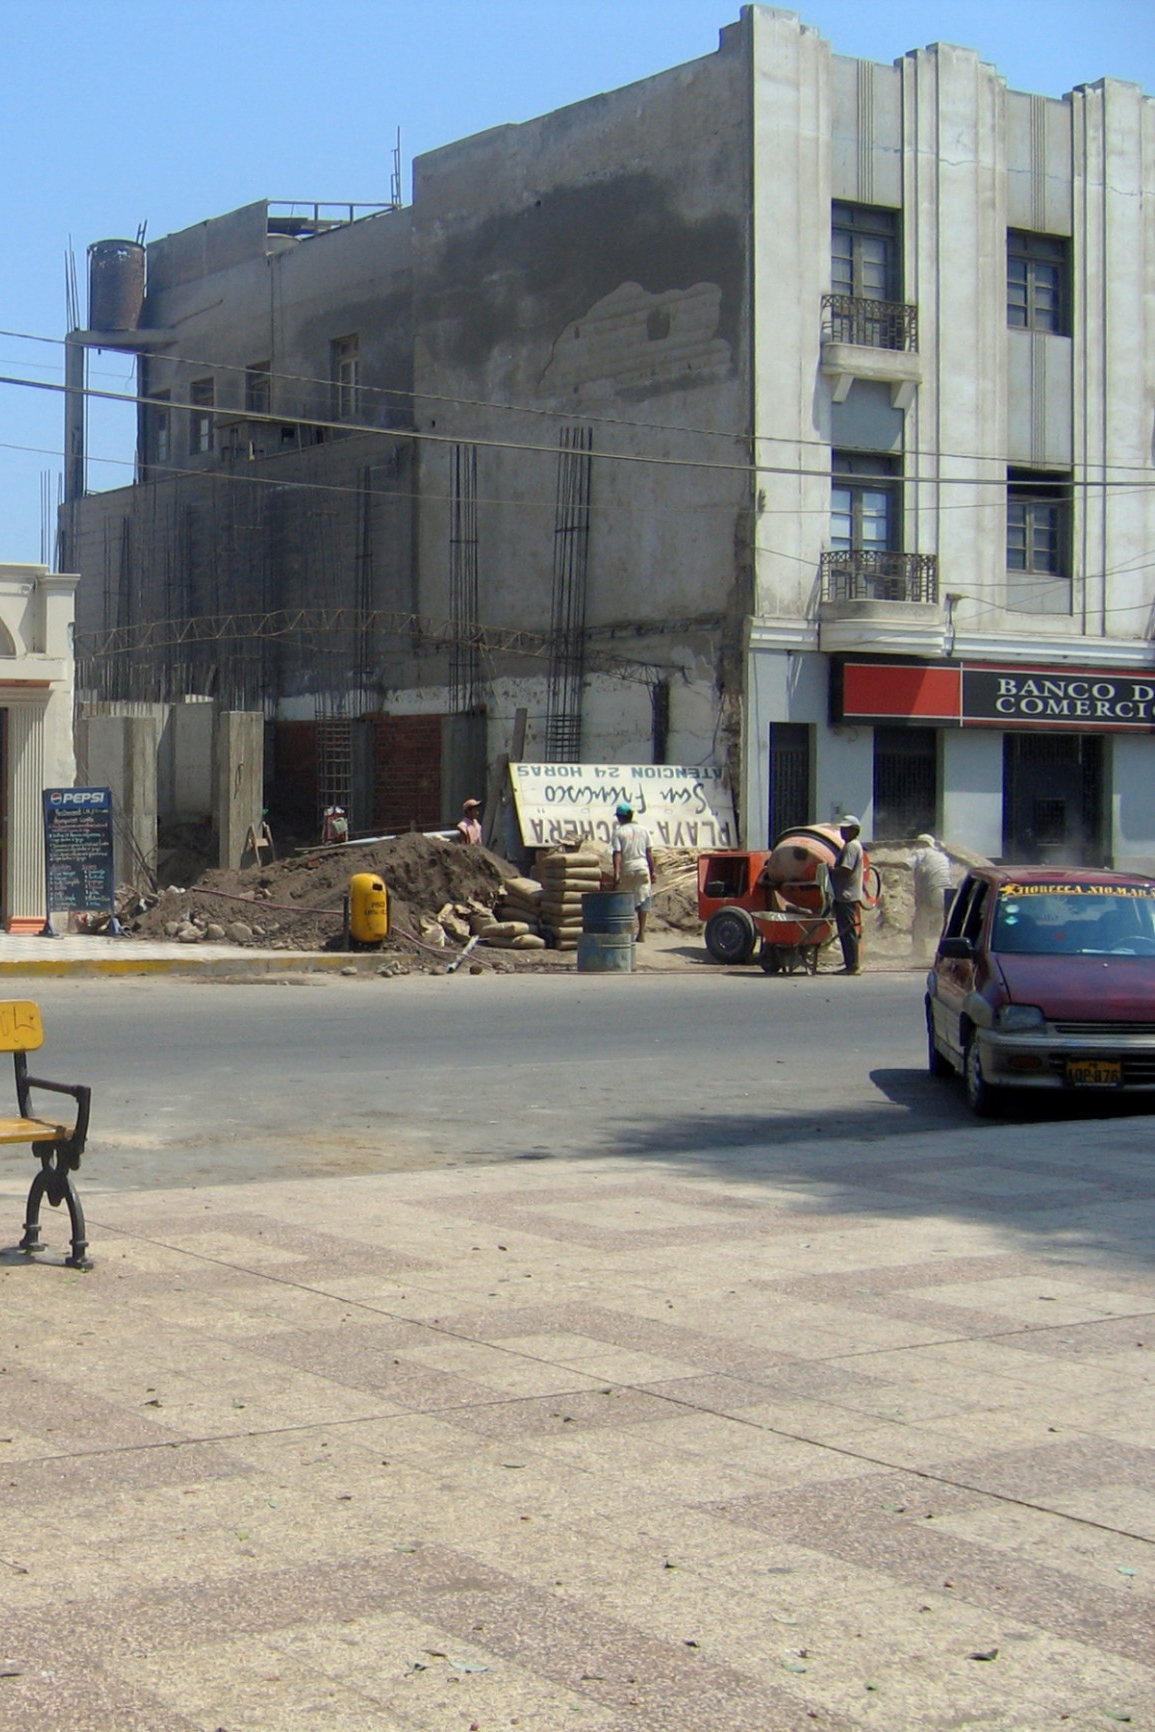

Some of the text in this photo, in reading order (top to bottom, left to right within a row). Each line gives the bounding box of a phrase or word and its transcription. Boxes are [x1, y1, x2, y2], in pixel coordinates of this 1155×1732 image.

[997, 678, 1155, 701] BANCO D
[516, 765, 723, 779] ATENCION 24 HORAS
[62, 792, 105, 804] PEPSI
[529, 818, 637, 843] CHERA
